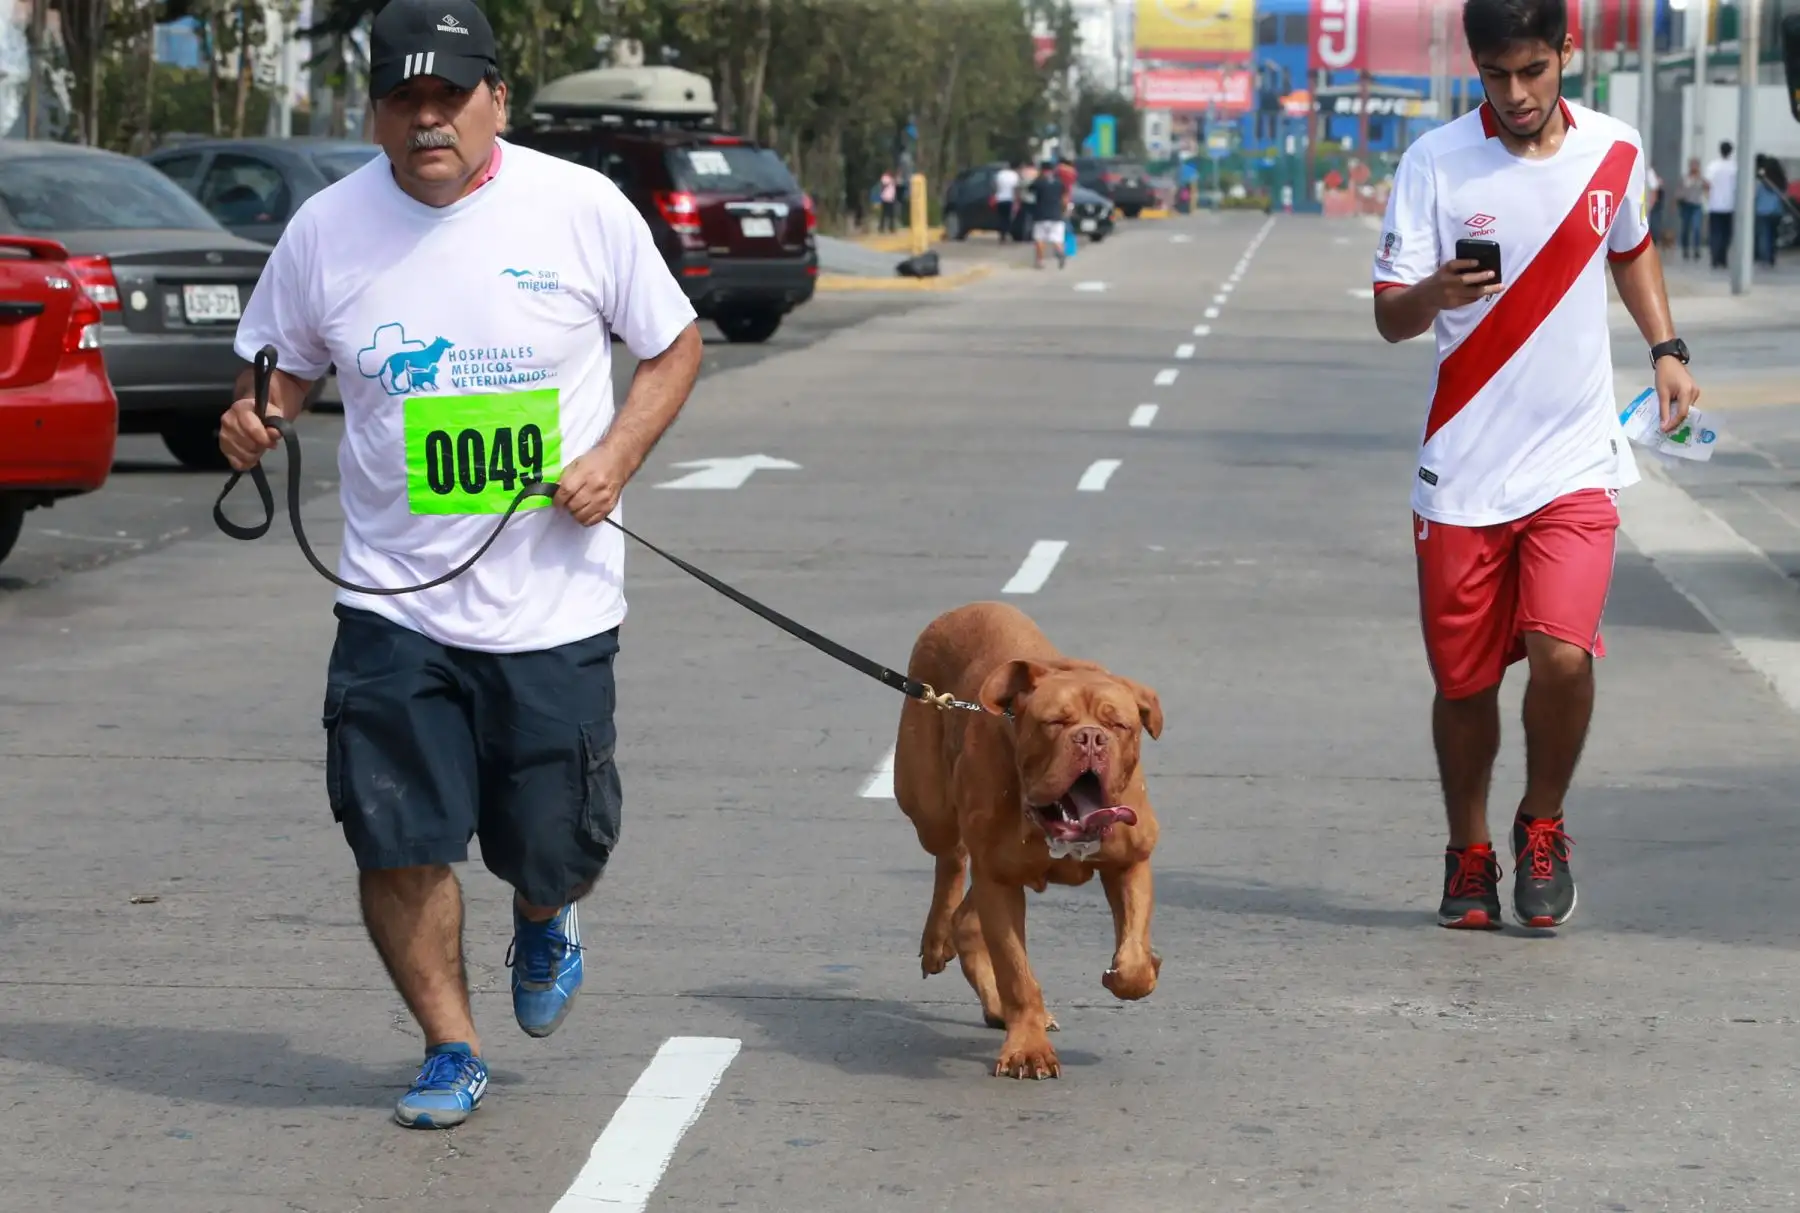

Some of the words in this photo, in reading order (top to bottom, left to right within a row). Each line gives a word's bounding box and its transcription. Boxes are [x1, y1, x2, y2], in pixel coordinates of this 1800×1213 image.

[1468, 228, 1496, 238] umbro
[538, 270, 559, 279] san
[517, 279, 559, 292] miguel
[448, 347, 533, 361] HOSPITALES
[451, 369, 547, 388] VETERINARIOS
[425, 423, 544, 495] 0049
